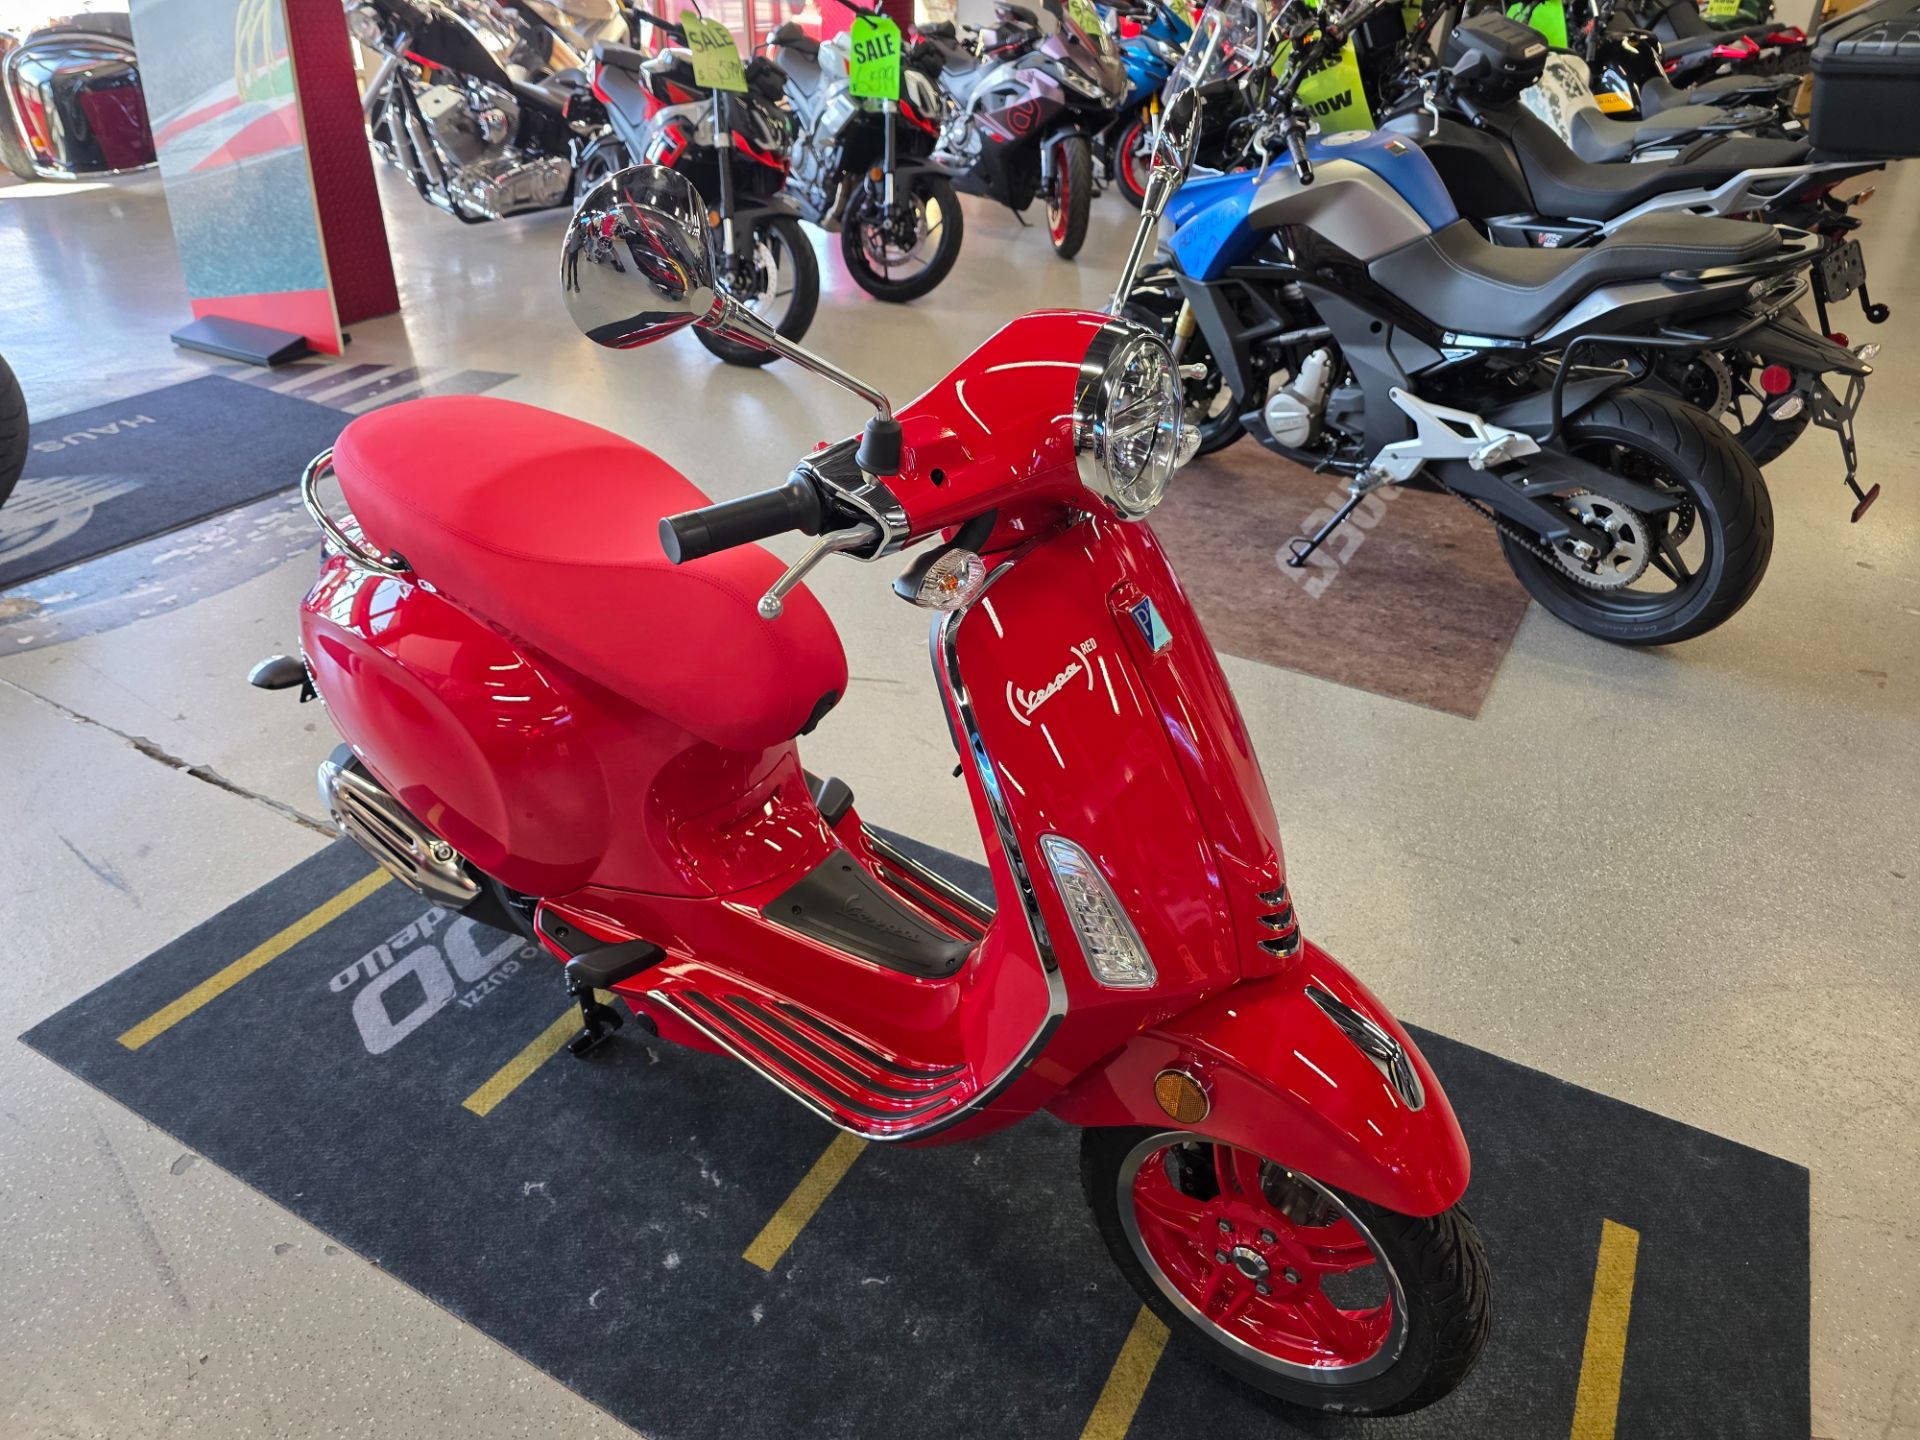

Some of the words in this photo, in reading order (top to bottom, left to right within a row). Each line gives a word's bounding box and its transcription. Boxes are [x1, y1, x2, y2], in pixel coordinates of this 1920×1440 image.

[688, 27, 735, 53] SALE
[854, 33, 895, 64] SALE
[1080, 637, 1098, 655] RED
[457, 960, 521, 1009] GUZZI
